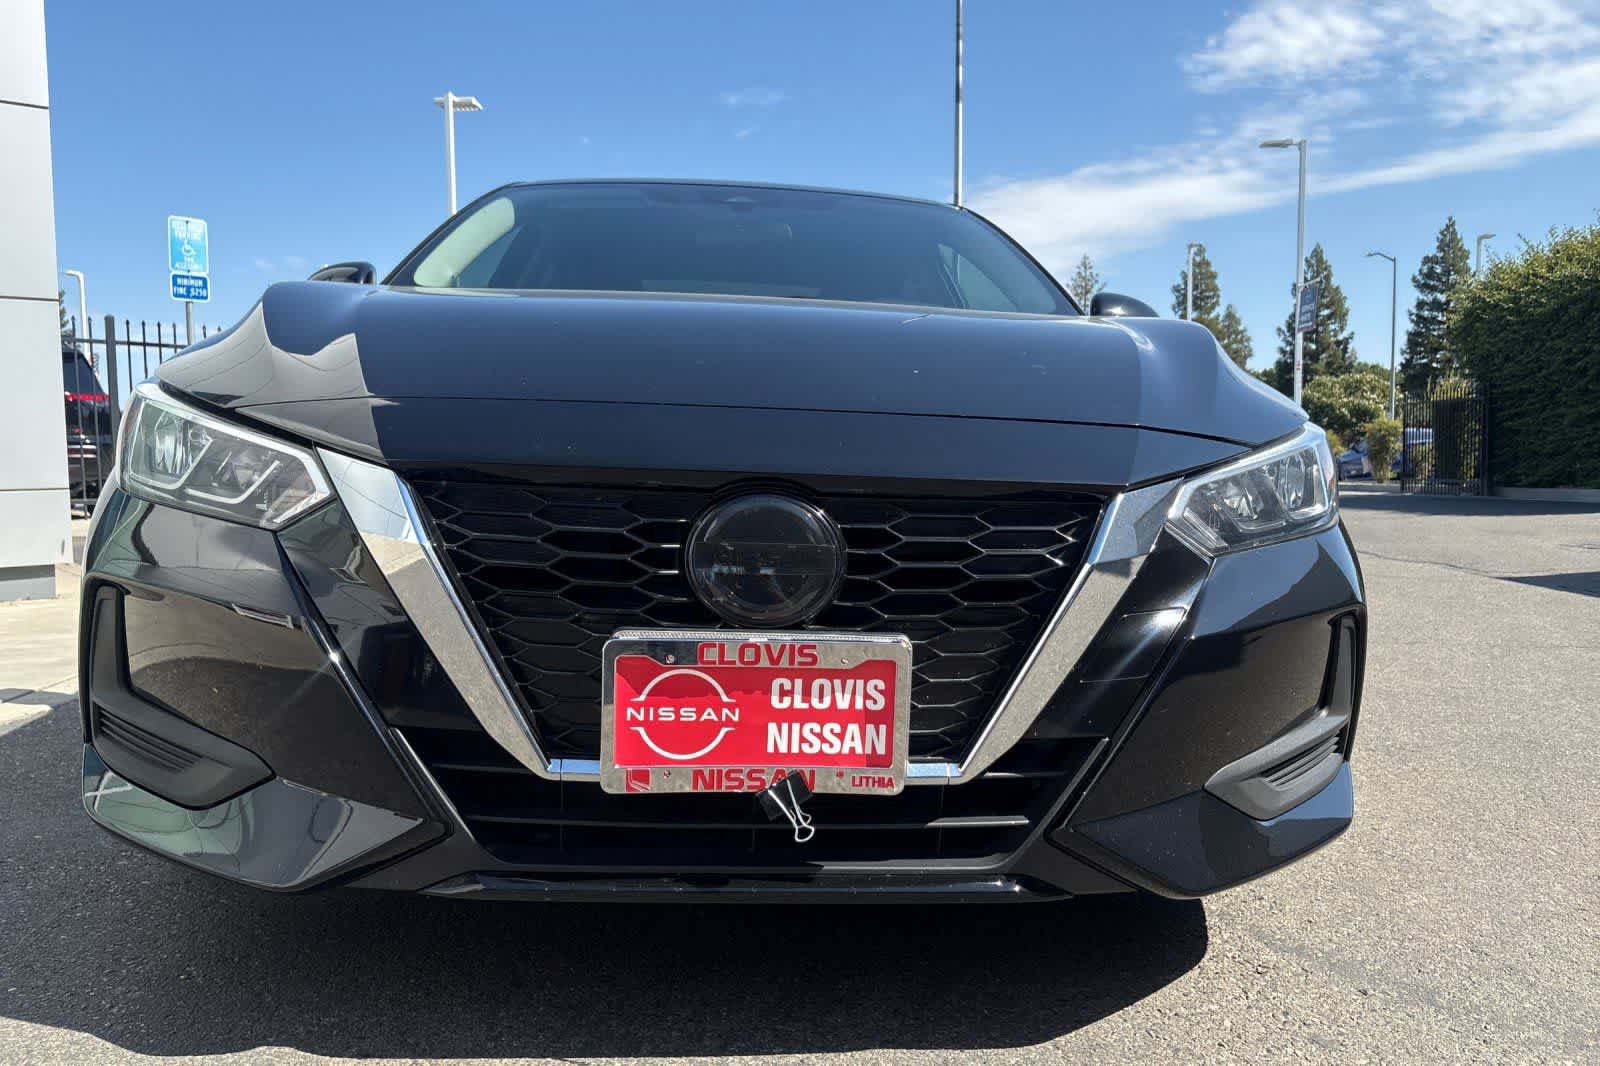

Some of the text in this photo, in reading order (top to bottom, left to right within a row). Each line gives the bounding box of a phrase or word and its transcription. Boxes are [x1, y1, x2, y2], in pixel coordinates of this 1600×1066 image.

[176, 278, 203, 287] MINIMUM
[697, 642, 820, 666] CLOVIS
[770, 678, 886, 710] CLOVIS
[626, 707, 740, 722] NISSAN
[767, 722, 887, 755] NISSAN
[851, 775, 895, 789] LITHIA
